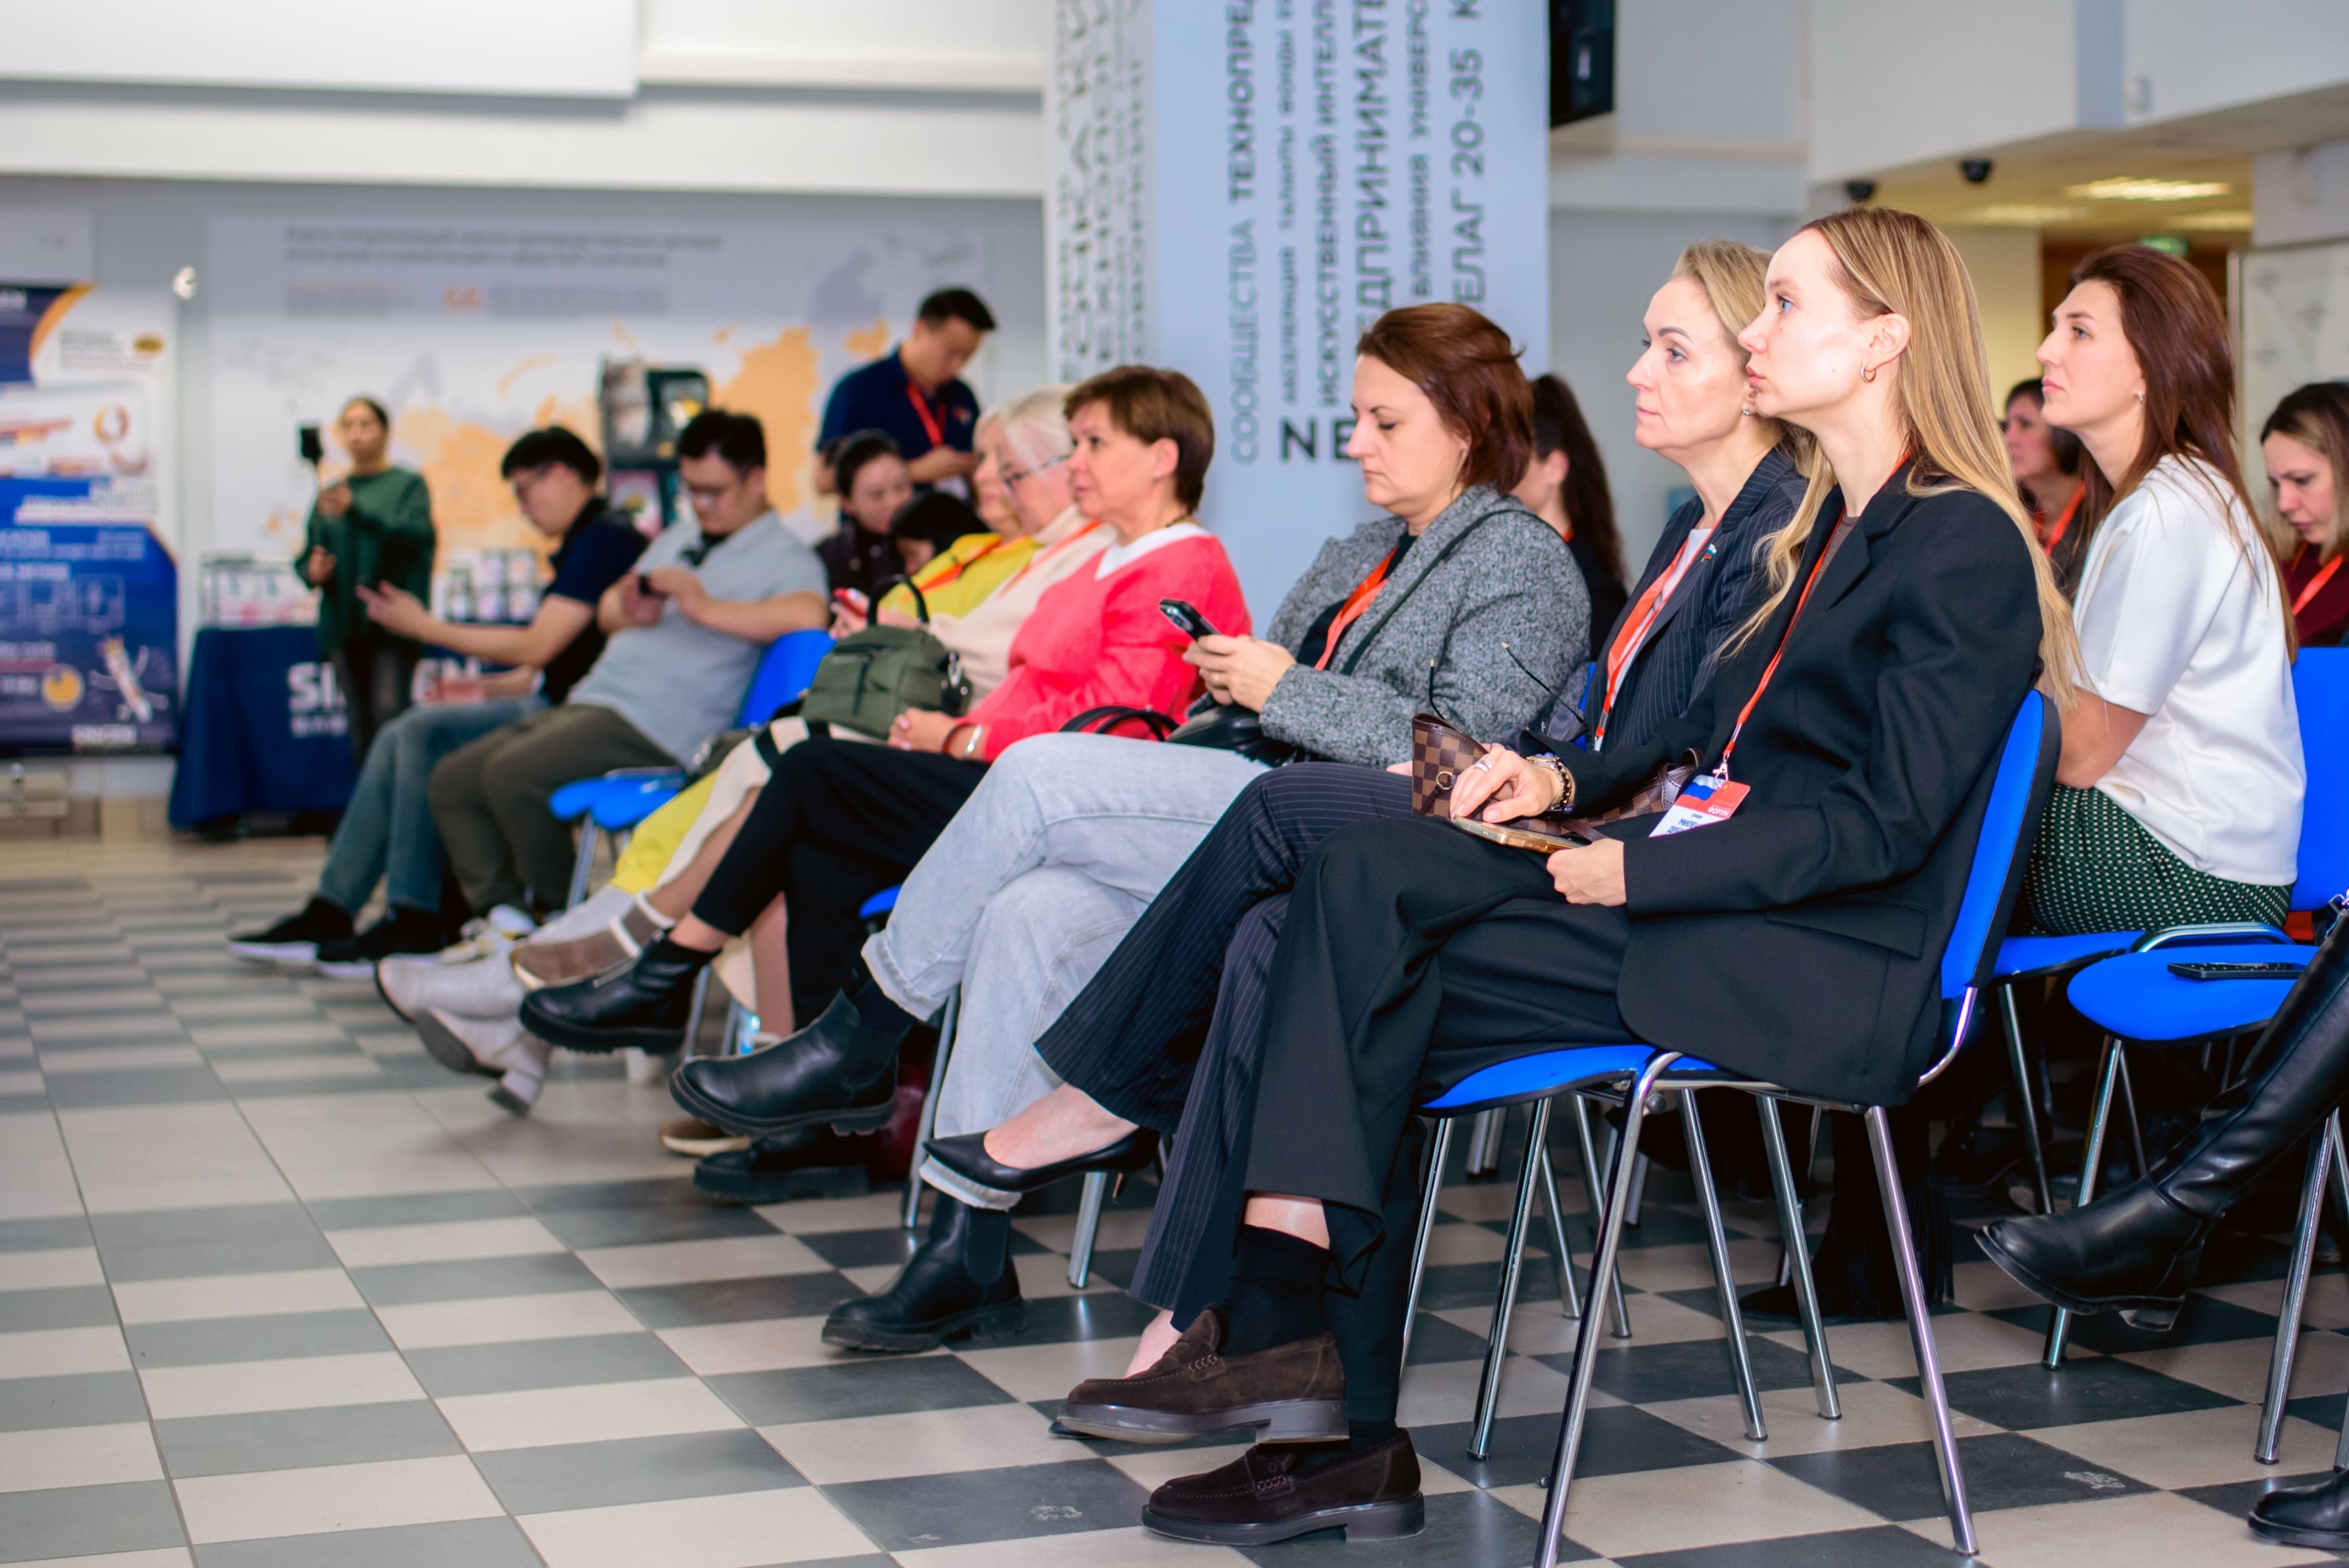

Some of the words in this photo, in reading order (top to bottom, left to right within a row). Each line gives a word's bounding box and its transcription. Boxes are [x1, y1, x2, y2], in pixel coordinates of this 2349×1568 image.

[1225, 0, 1256, 205] ТЕХНОПРЕ
[1449, 48, 1485, 177] 20-35
[1309, 134, 1340, 406] ИСКУССТВЕННЫЙ
[1408, 154, 1431, 298] ВЛИЯНИЯ
[1451, 185, 1486, 306] ЕЛАГ
[1230, 217, 1259, 463] СООБЩЕСТВА
[1678, 818, 1700, 828] МИЛЕ
[1708, 806, 1730, 817] ФОРУМ
